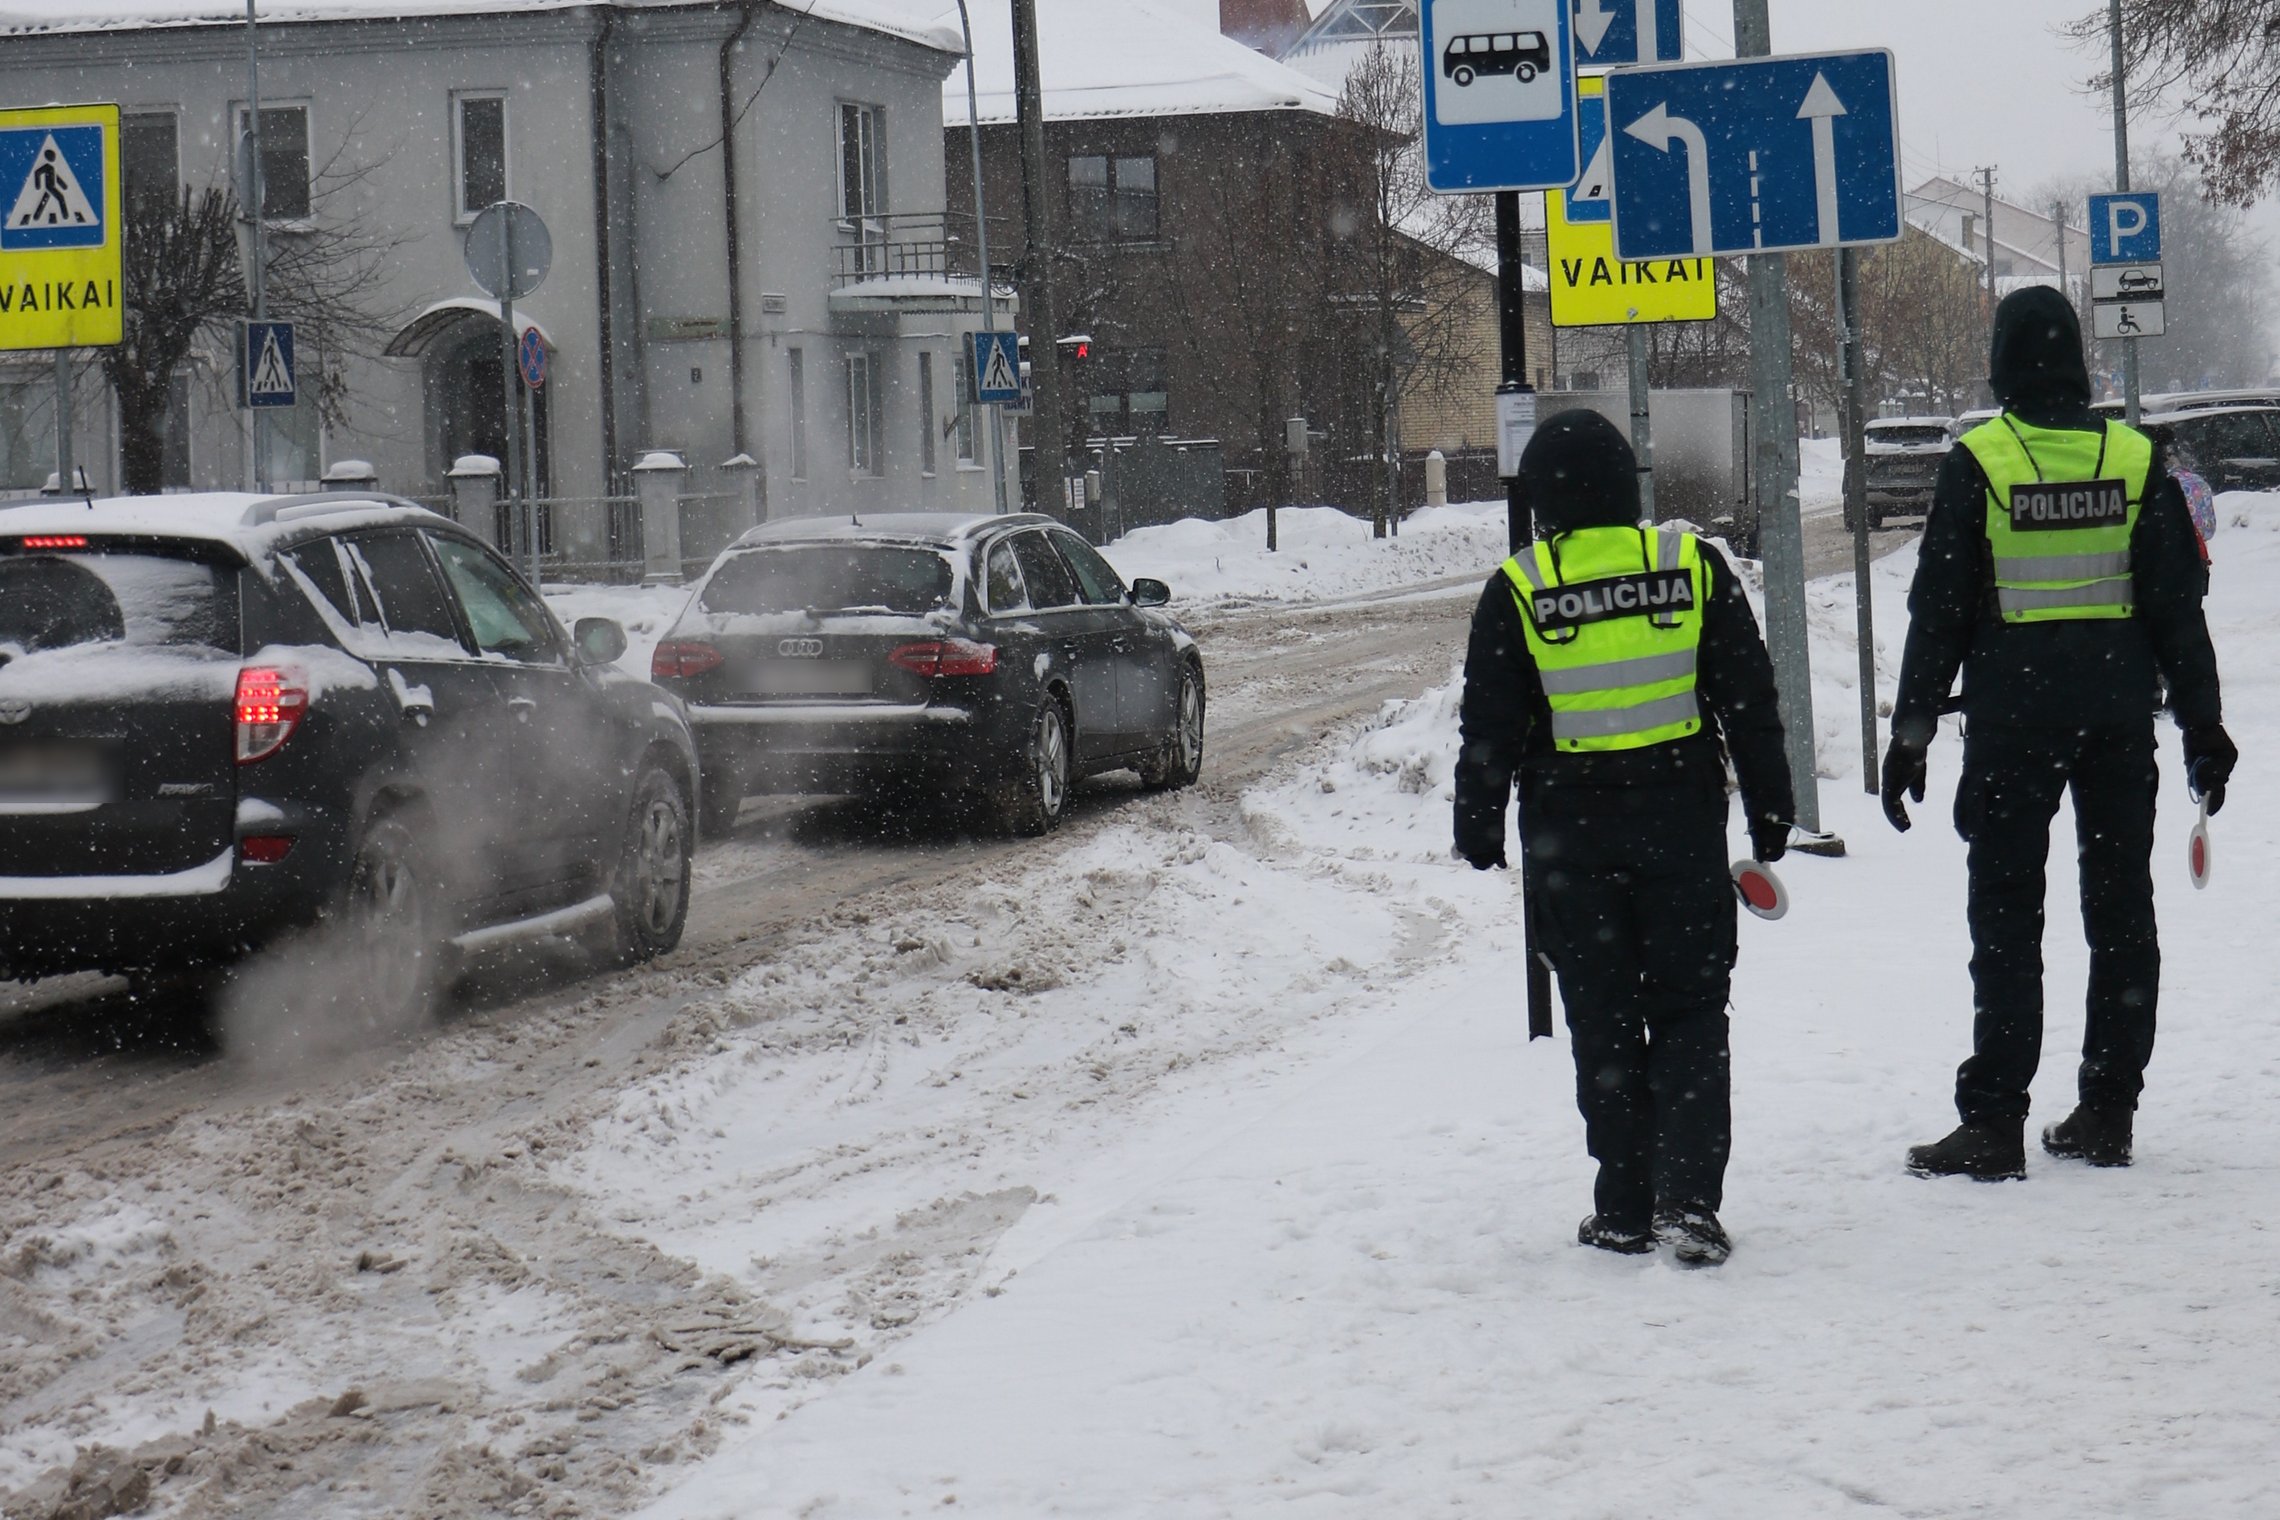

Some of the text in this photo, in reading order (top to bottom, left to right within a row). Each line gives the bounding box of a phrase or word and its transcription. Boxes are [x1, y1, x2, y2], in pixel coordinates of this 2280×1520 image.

[2109, 202, 2147, 256] P
[1560, 257, 1703, 287] VAIKAI
[0, 280, 113, 312] VAIKAI
[2013, 489, 2123, 520] POLICIJA
[1534, 577, 1692, 624] POLICIJA
